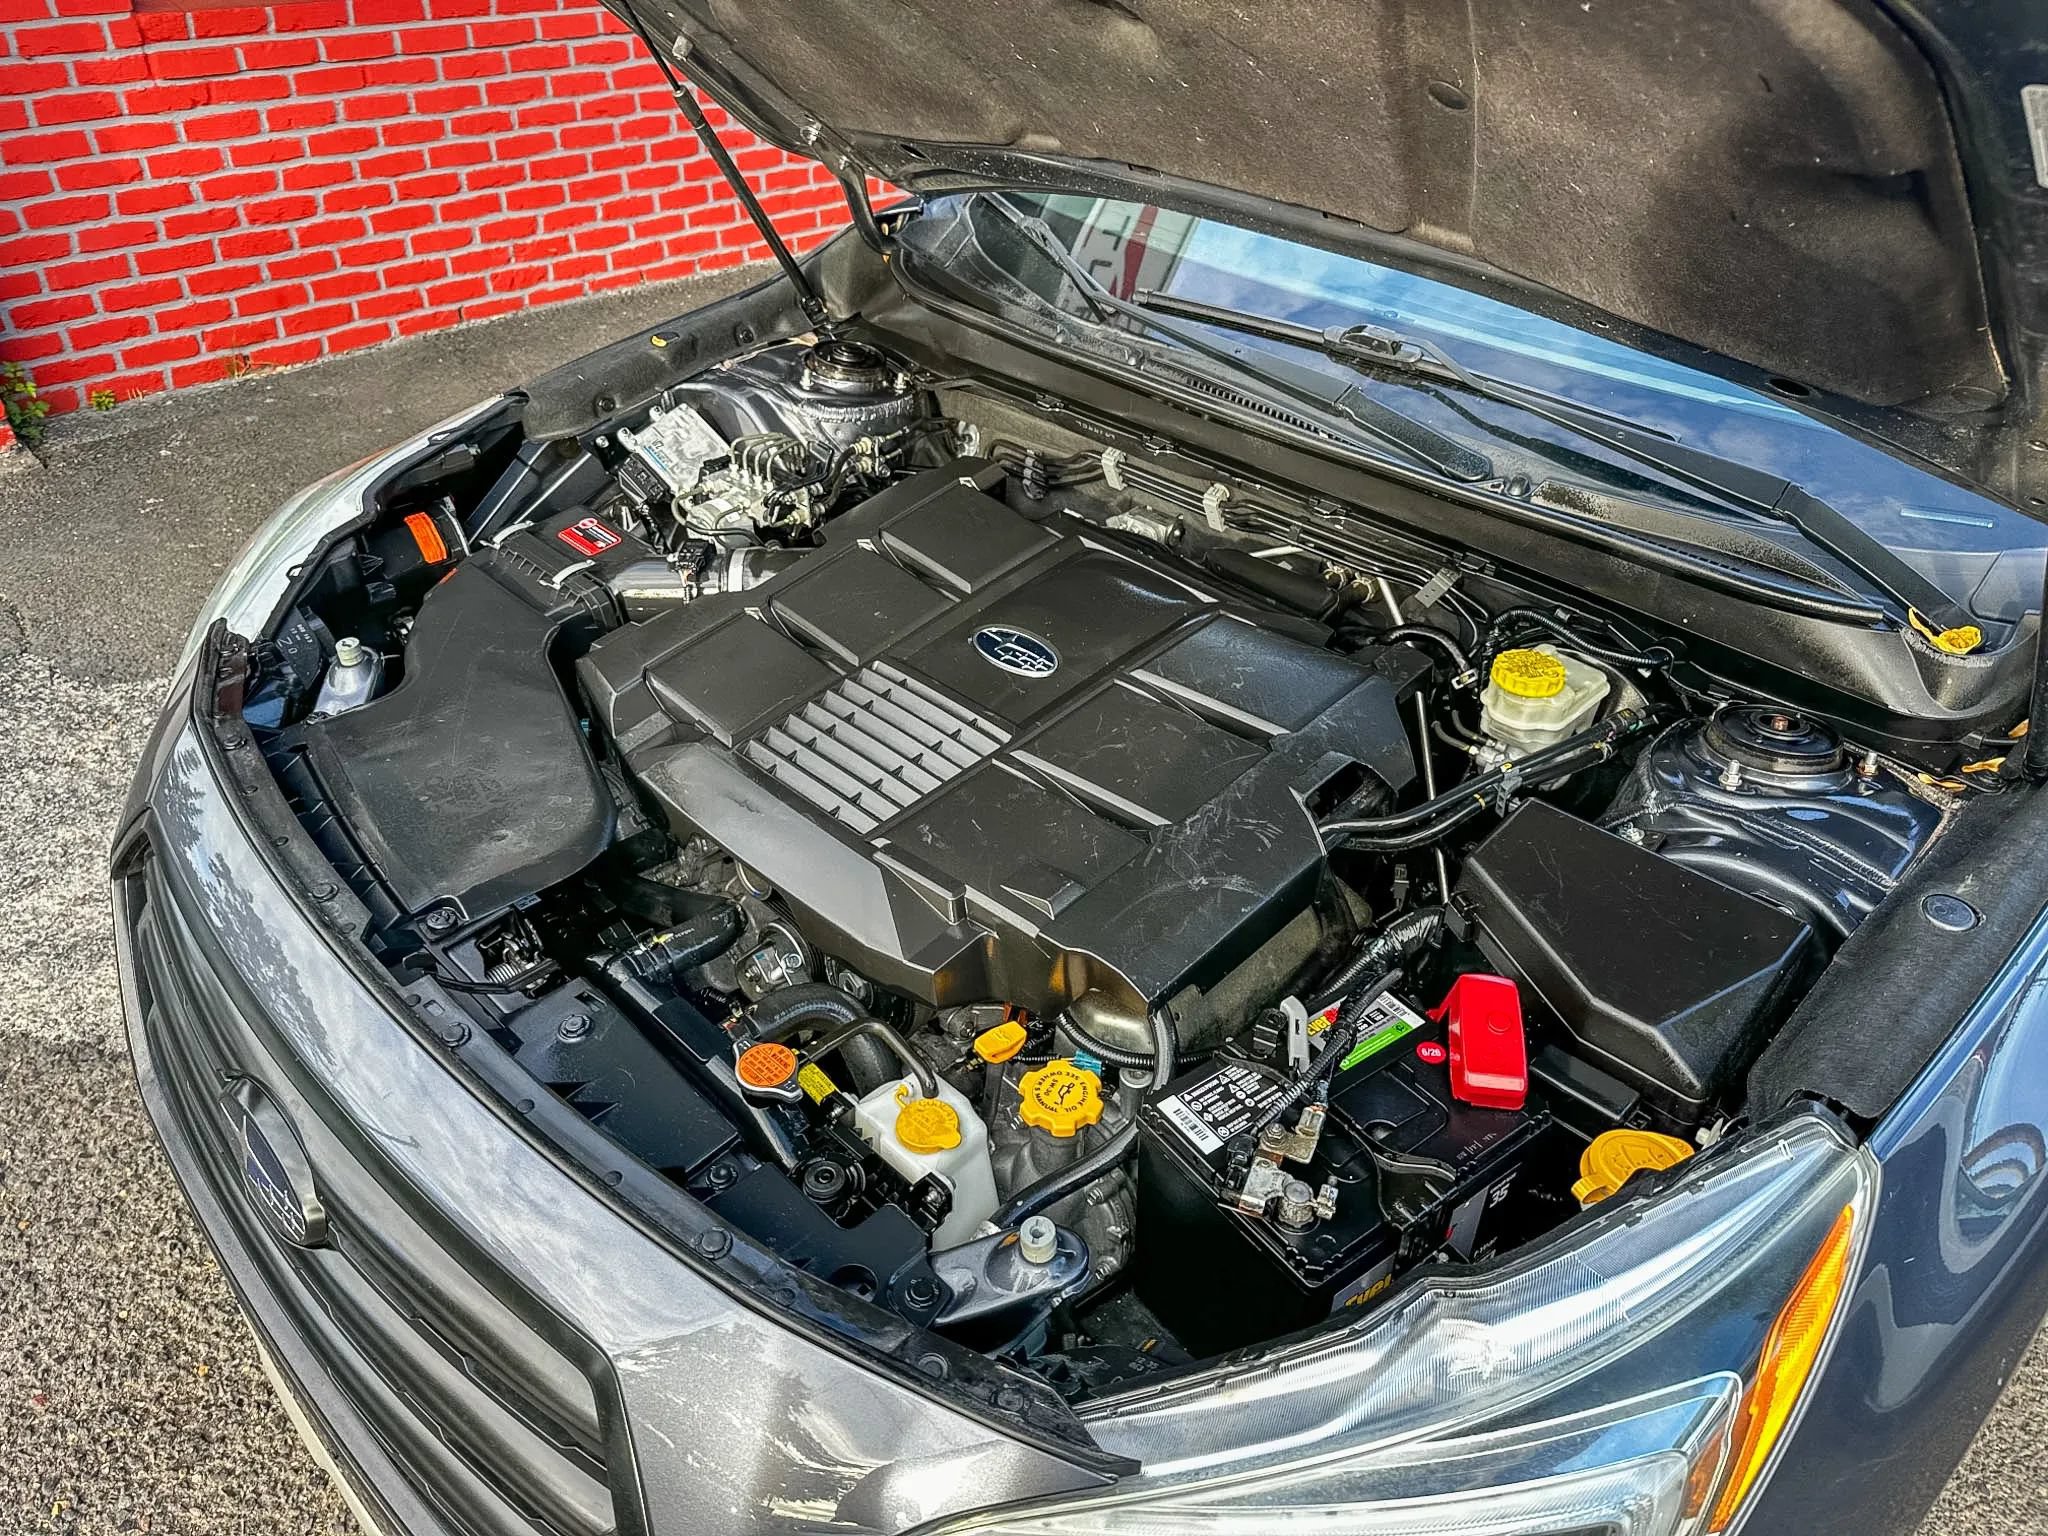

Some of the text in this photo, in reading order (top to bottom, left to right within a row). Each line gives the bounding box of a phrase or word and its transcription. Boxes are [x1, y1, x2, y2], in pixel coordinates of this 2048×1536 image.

[1065, 1071, 1080, 1081] SEE
[1035, 1094, 1058, 1113] MANUAL
[1064, 1081, 1089, 1113] ENGINE OIL
[1489, 1182, 1510, 1209] 35
